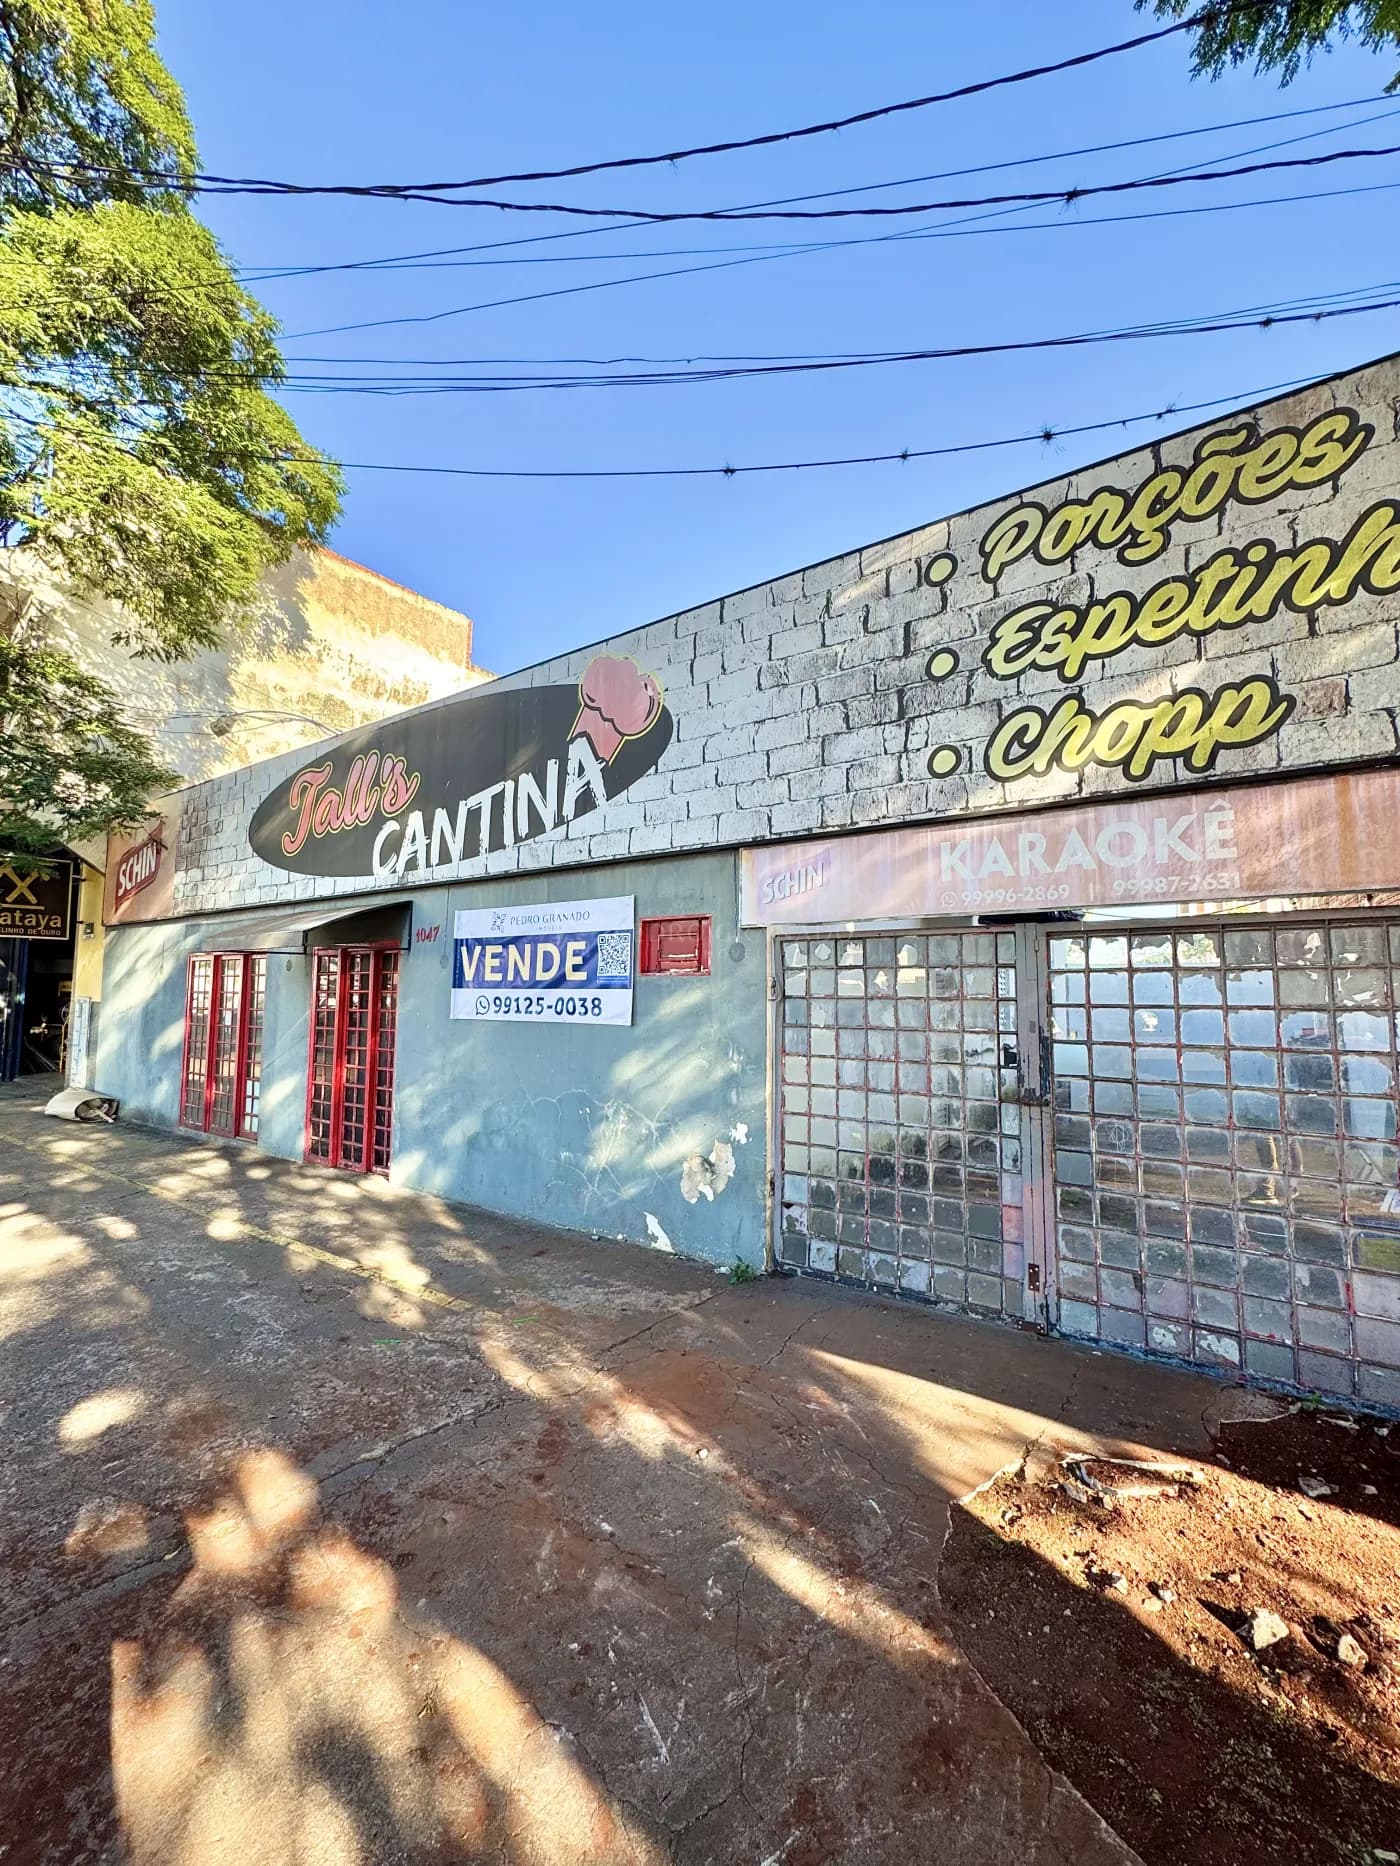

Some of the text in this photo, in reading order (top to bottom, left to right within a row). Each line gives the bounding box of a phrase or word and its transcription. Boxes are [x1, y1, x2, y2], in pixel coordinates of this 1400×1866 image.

[981, 409, 1371, 581] Porções
[984, 503, 1400, 680] Espetinh
[986, 678, 1293, 779] Chopp
[282, 750, 421, 857] Tall's
[373, 736, 609, 877] CANTINA
[940, 798, 1238, 882] KARAOKÊ
[118, 842, 157, 897] SCHIN
[762, 861, 825, 904] SCHIN
[961, 871, 1241, 906] 99996-2869 99987-2631
[0, 910, 62, 930] ataya
[416, 924, 441, 943] 1047
[510, 911, 591, 926] PEDRO GRANADO
[460, 941, 588, 982] VENDE
[493, 996, 603, 1017] 99125-0038
